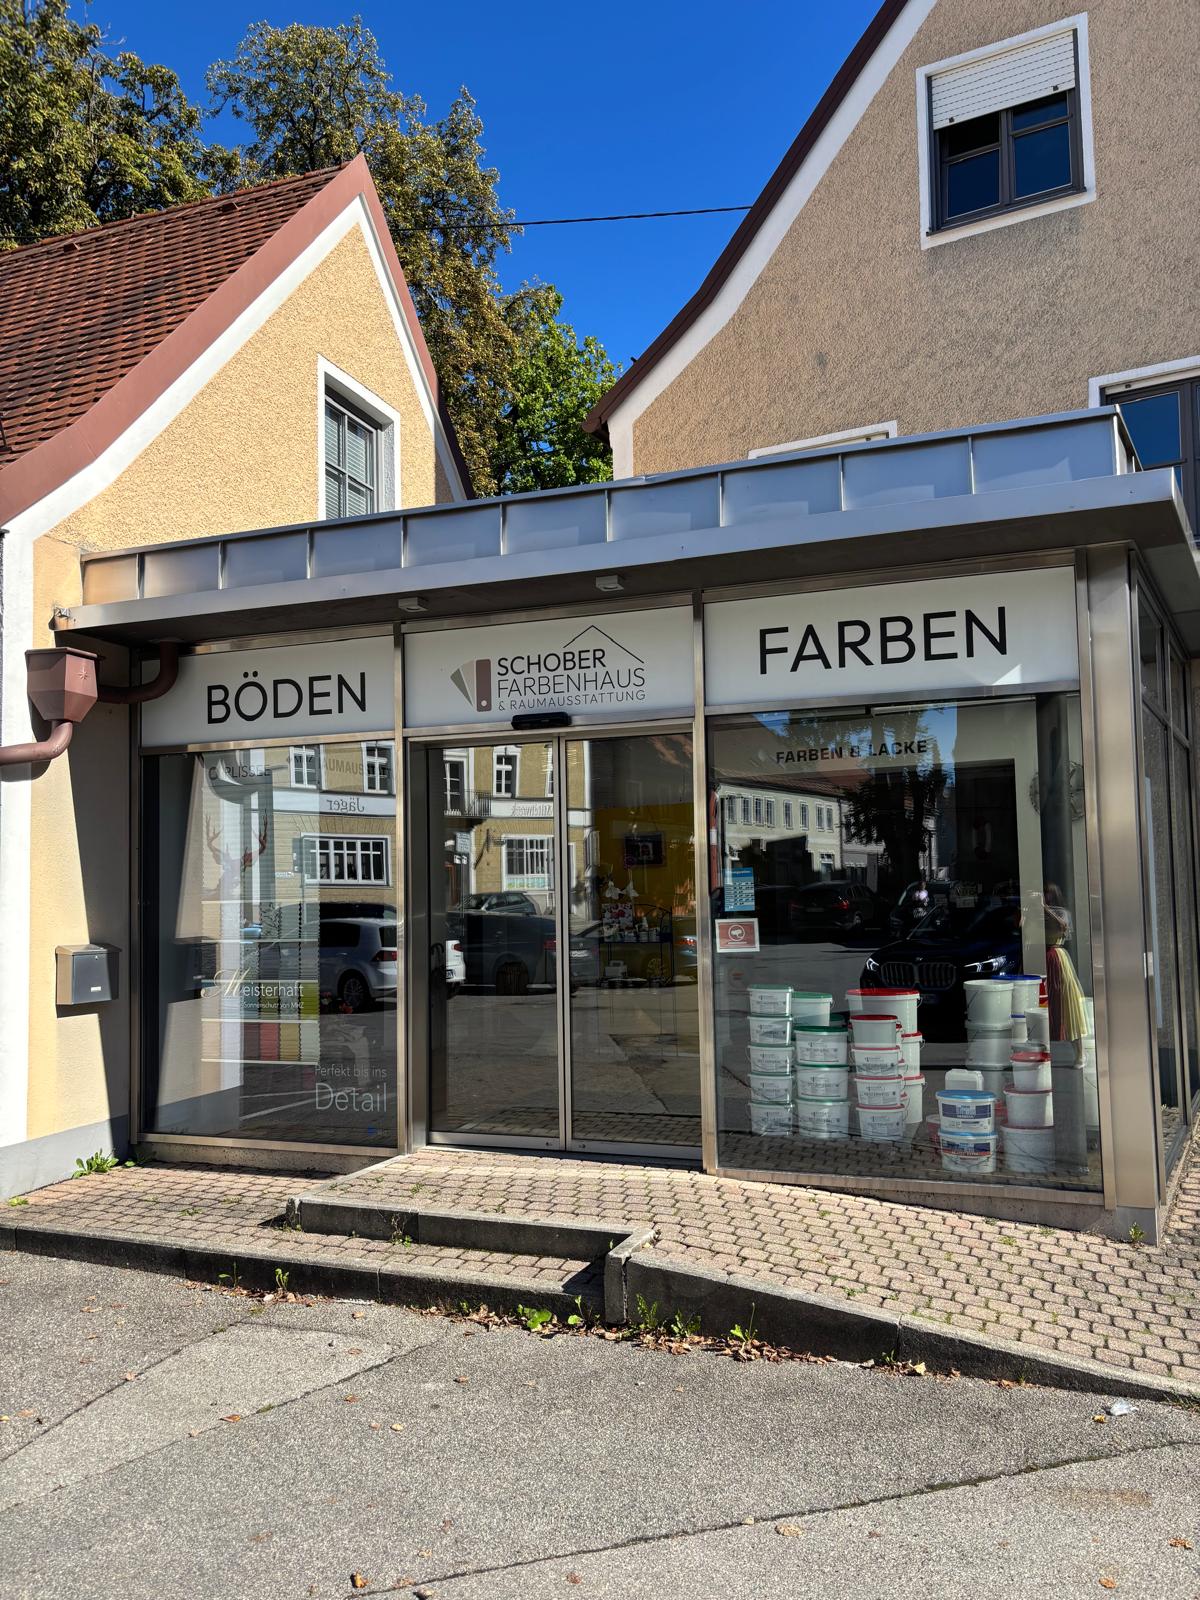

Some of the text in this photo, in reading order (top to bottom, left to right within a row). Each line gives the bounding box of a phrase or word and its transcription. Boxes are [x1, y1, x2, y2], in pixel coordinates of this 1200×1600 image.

[759, 606, 1007, 675] FARBEN
[497, 648, 606, 676] SCHOBER
[207, 670, 366, 724] BÖDEN
[497, 667, 646, 698] FARBENHAUS
[498, 689, 646, 711] & RAUMAUSSTATTUNG
[776, 740, 927, 764] FARBEN & LACKE
[200, 967, 304, 998] Meisterhaft
[315, 1063, 388, 1078] Perfekt bis ins
[315, 1082, 388, 1112] Detail
